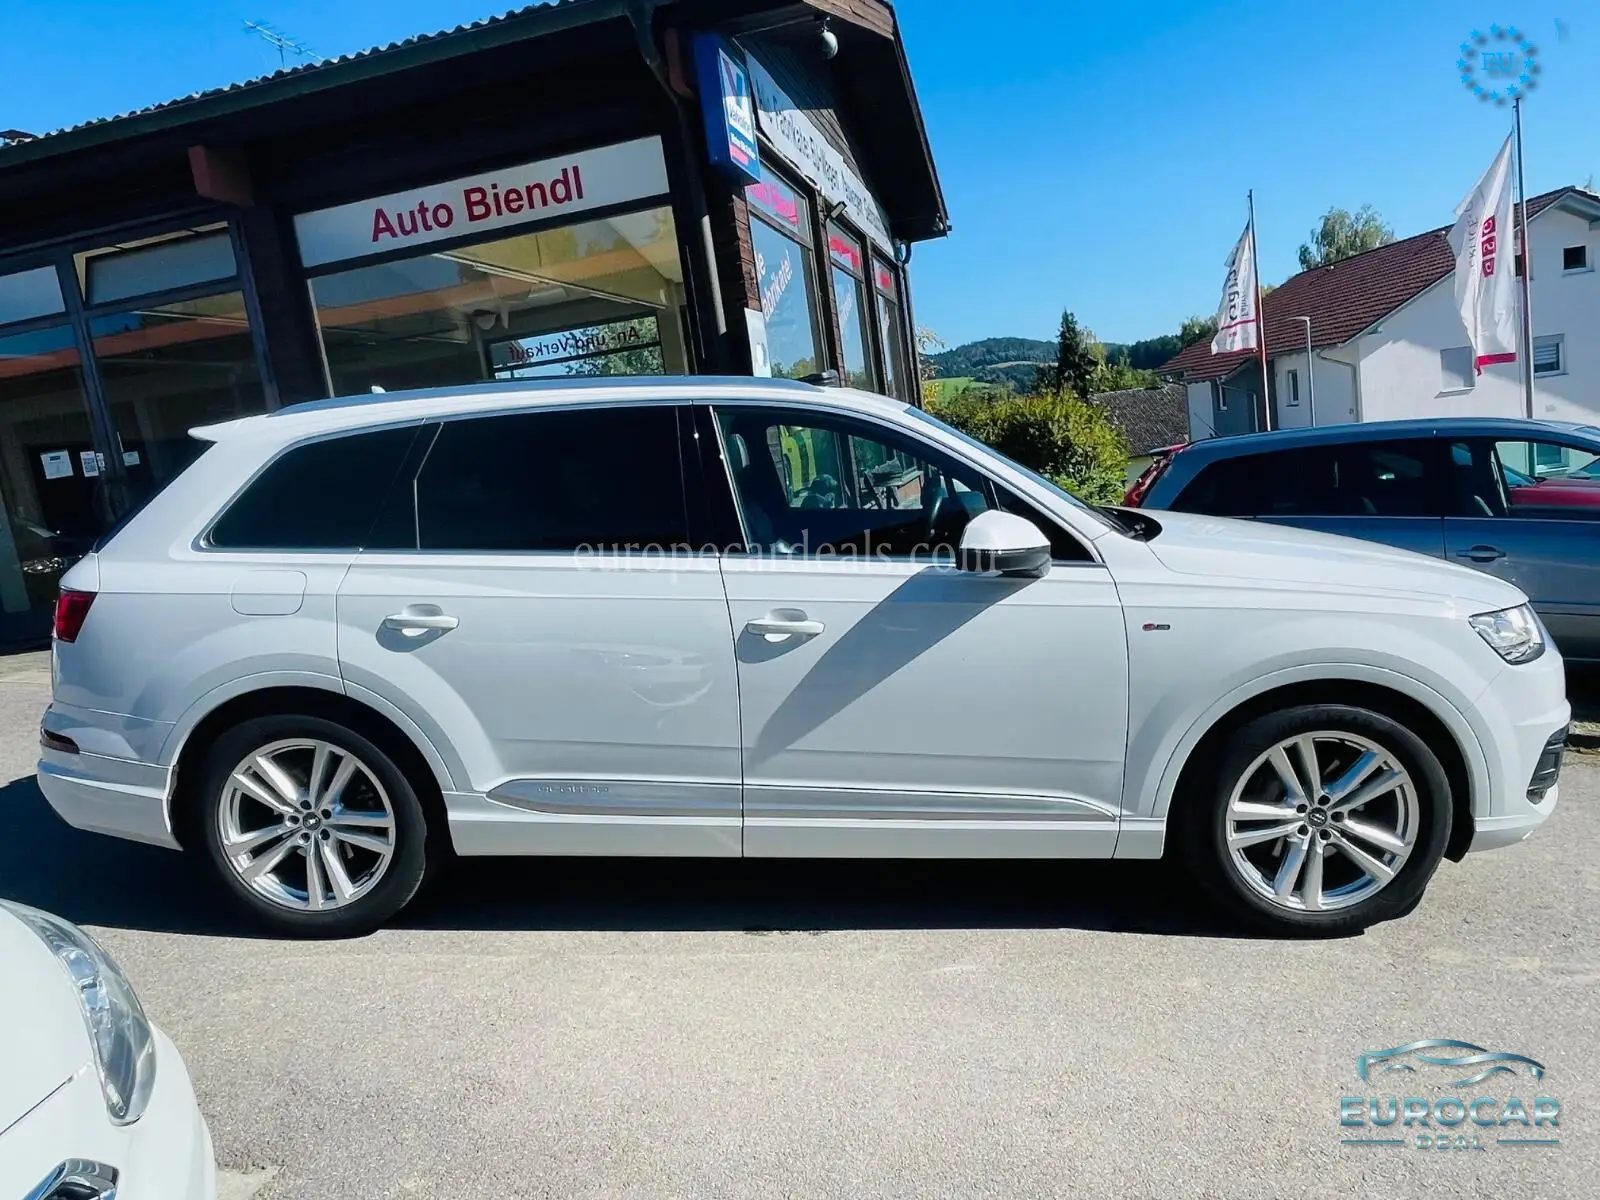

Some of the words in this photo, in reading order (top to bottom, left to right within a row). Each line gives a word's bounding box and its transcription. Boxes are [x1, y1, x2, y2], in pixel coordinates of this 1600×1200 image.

[372, 200, 454, 243] Auto
[463, 165, 584, 223] Biendl
[762, 248, 792, 322] abrikate!
